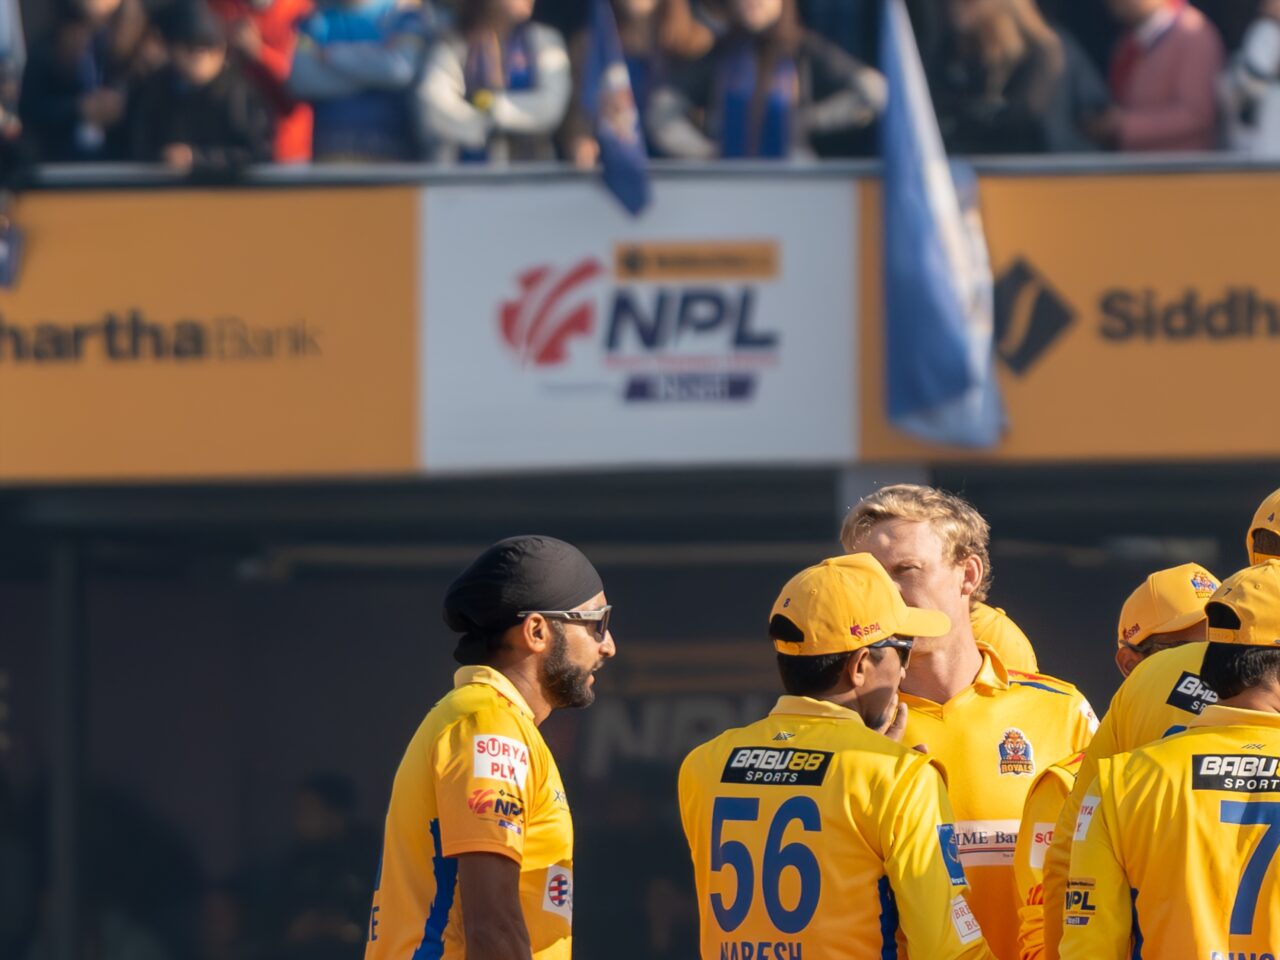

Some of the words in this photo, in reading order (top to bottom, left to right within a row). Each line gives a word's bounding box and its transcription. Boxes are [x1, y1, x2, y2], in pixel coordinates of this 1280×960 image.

[605, 286, 782, 352] NPL
[730, 749, 826, 770] BABU88
[745, 771, 798, 783] SPORTS
[709, 795, 822, 934] 56
